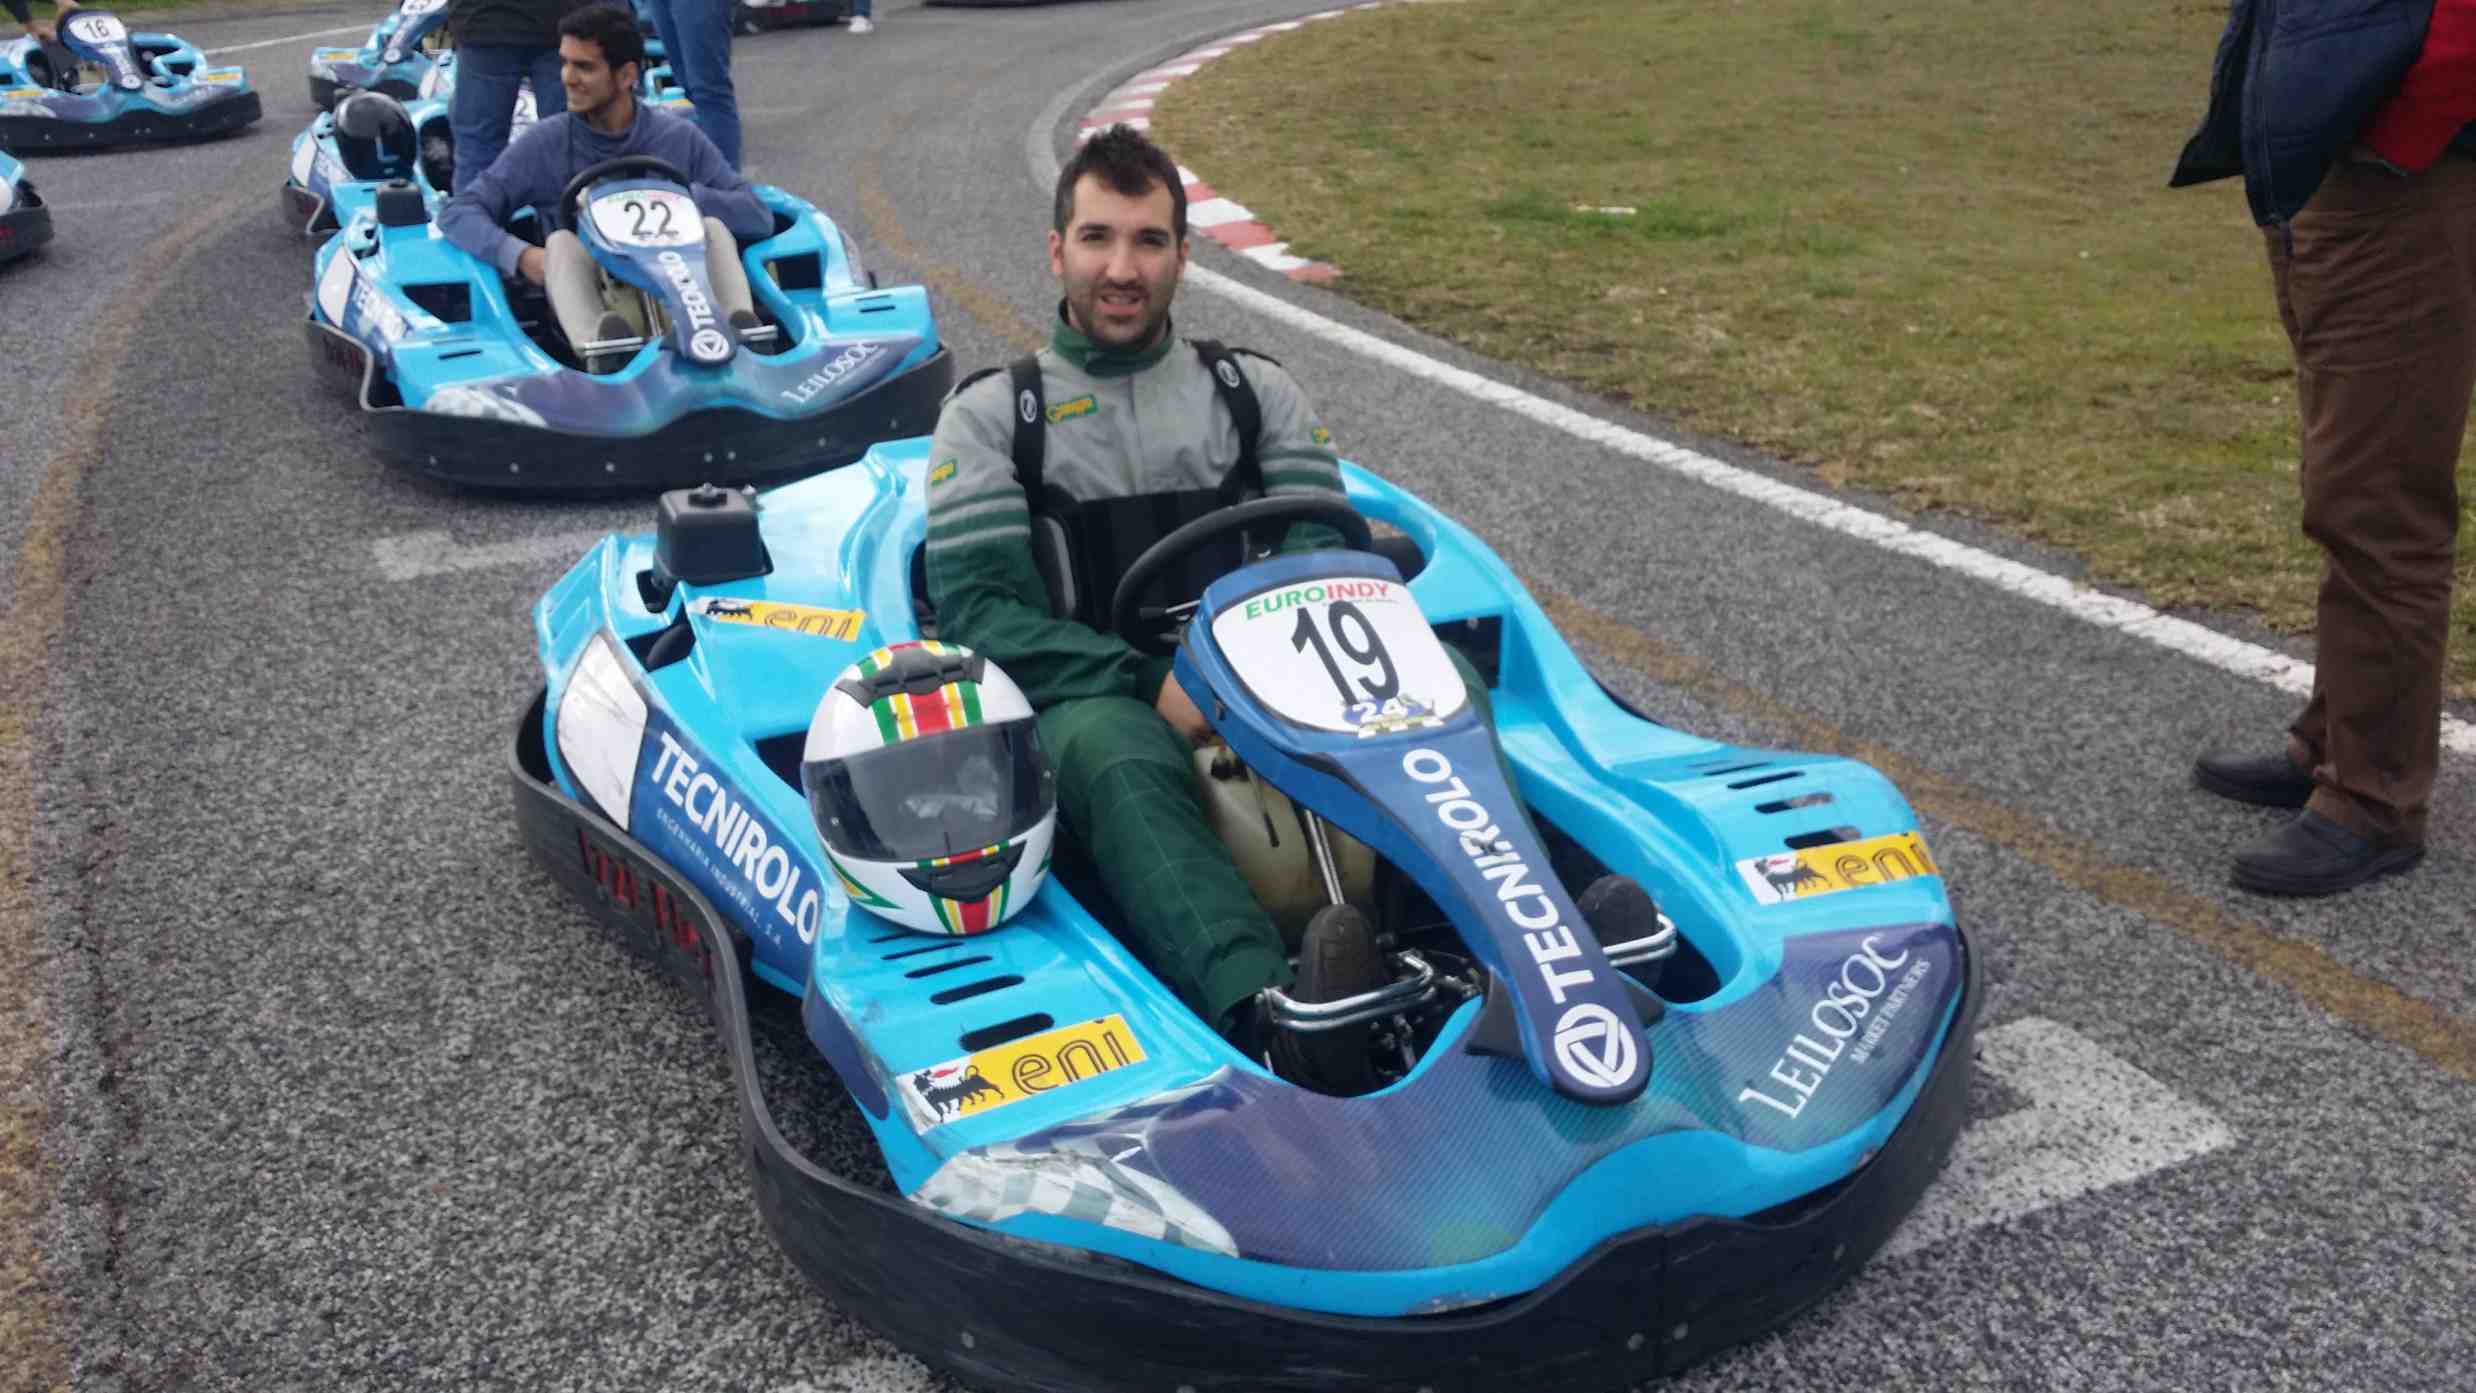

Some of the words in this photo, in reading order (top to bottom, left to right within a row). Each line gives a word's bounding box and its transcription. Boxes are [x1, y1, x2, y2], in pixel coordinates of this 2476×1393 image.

[85, 19, 110, 39] 16
[624, 200, 680, 239] 22
[1245, 583, 1389, 620] EUROINDY
[1291, 600, 1399, 705] 19
[650, 730, 819, 945] TECNIROLO
[1402, 748, 1595, 1005] TECNIROLO
[1012, 1018, 1131, 1096] eni
[1738, 935, 1909, 1119] LEILOSOC
